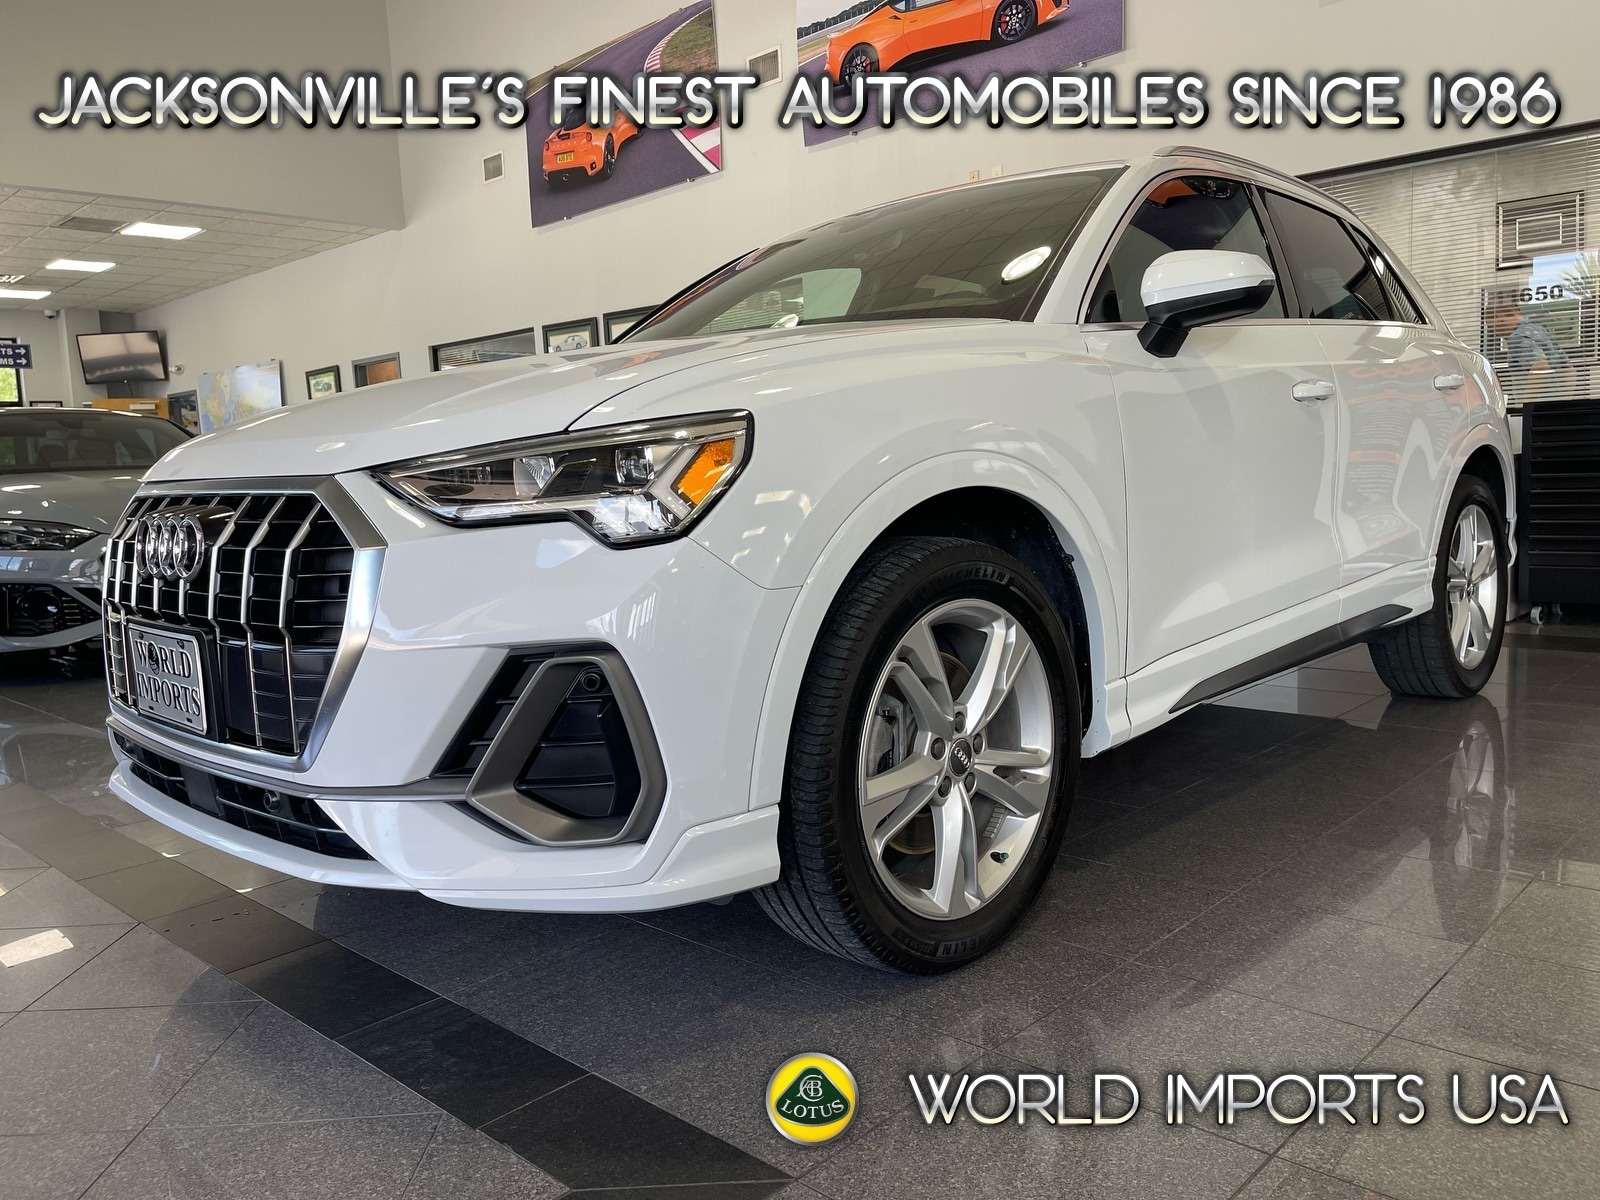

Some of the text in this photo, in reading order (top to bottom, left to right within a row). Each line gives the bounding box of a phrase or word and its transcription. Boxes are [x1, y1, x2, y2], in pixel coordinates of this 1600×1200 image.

[0, 347, 13, 355] TS
[135, 638, 194, 678] WORLD
[136, 671, 201, 717] IMPORTS
